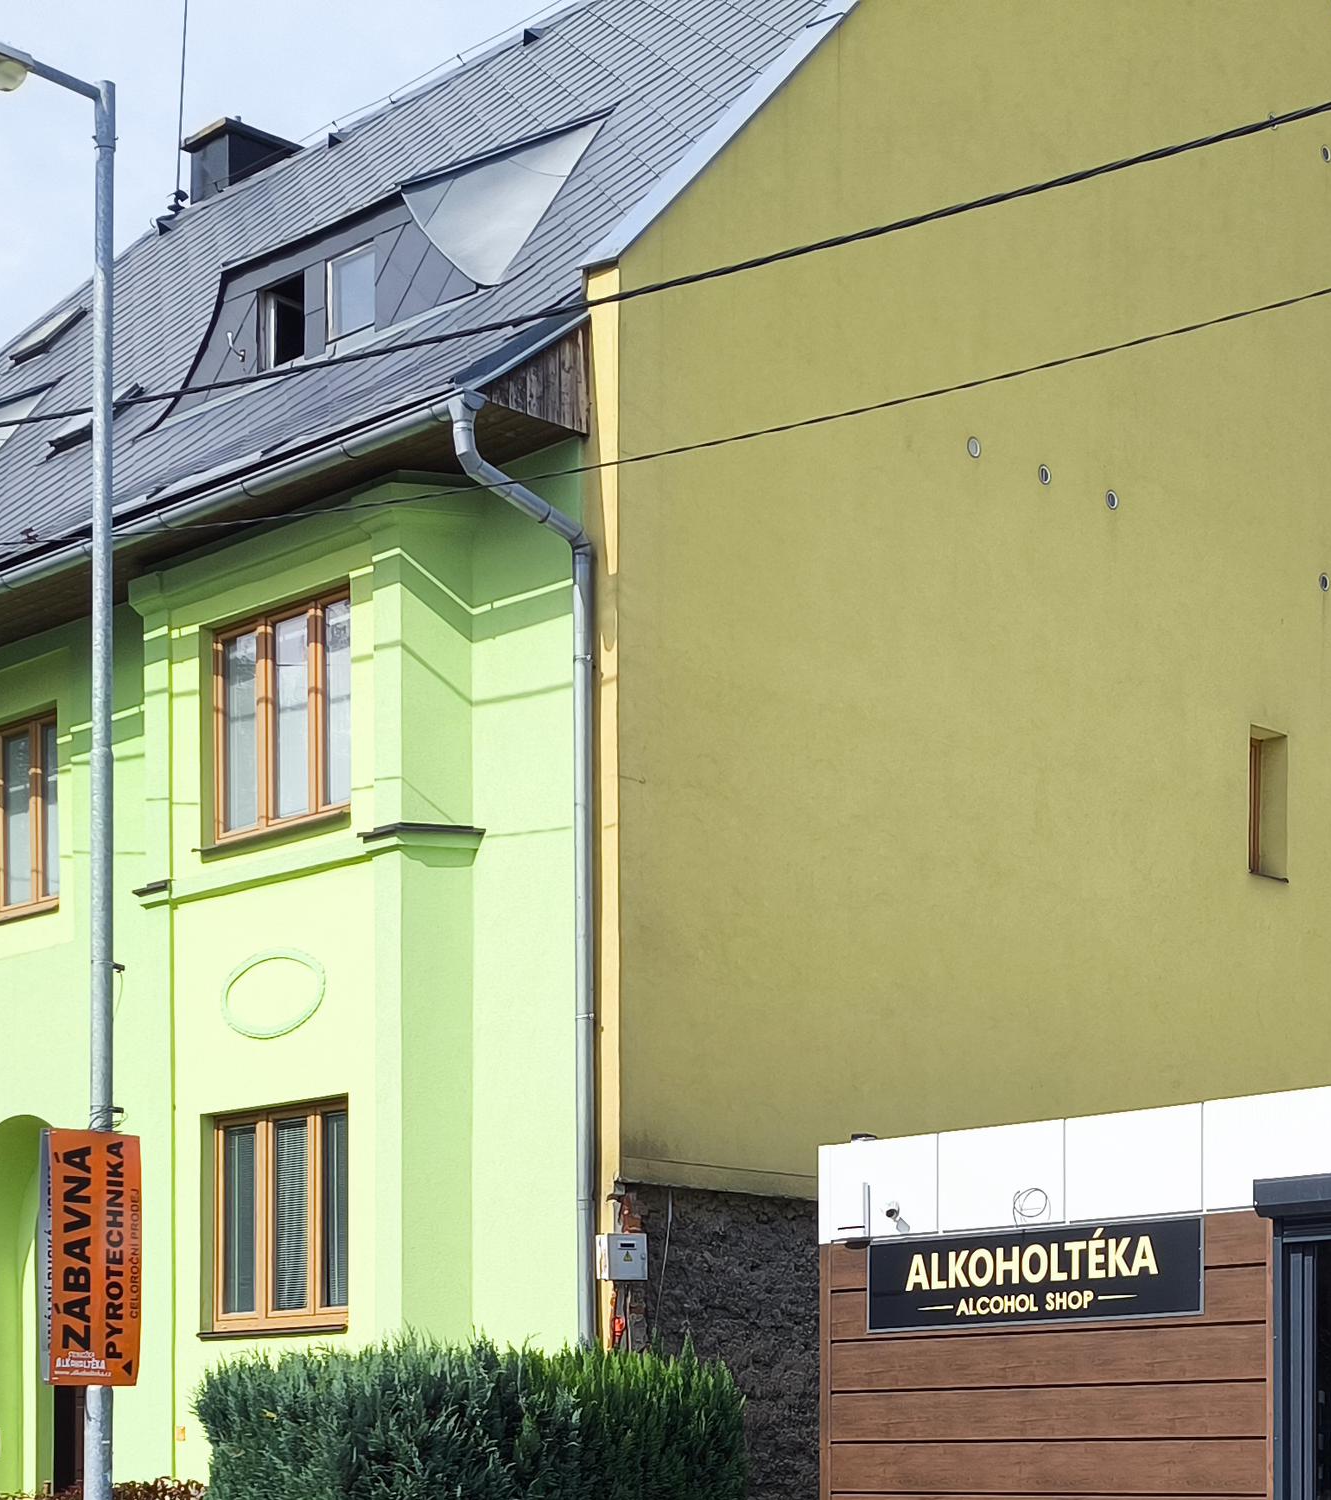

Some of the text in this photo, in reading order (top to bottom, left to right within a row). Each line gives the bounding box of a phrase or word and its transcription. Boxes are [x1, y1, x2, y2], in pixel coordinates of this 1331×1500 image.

[53, 1146, 92, 1351] ZÁBAVNÁ
[105, 1141, 124, 1360] PYROTECHNIKA
[129, 1188, 140, 1319] CELOROČNÍ PRODEJ
[905, 1228, 1159, 1292] ALKOHOLTÉKA
[955, 1289, 1095, 1317] ALCOHOL SHOP
